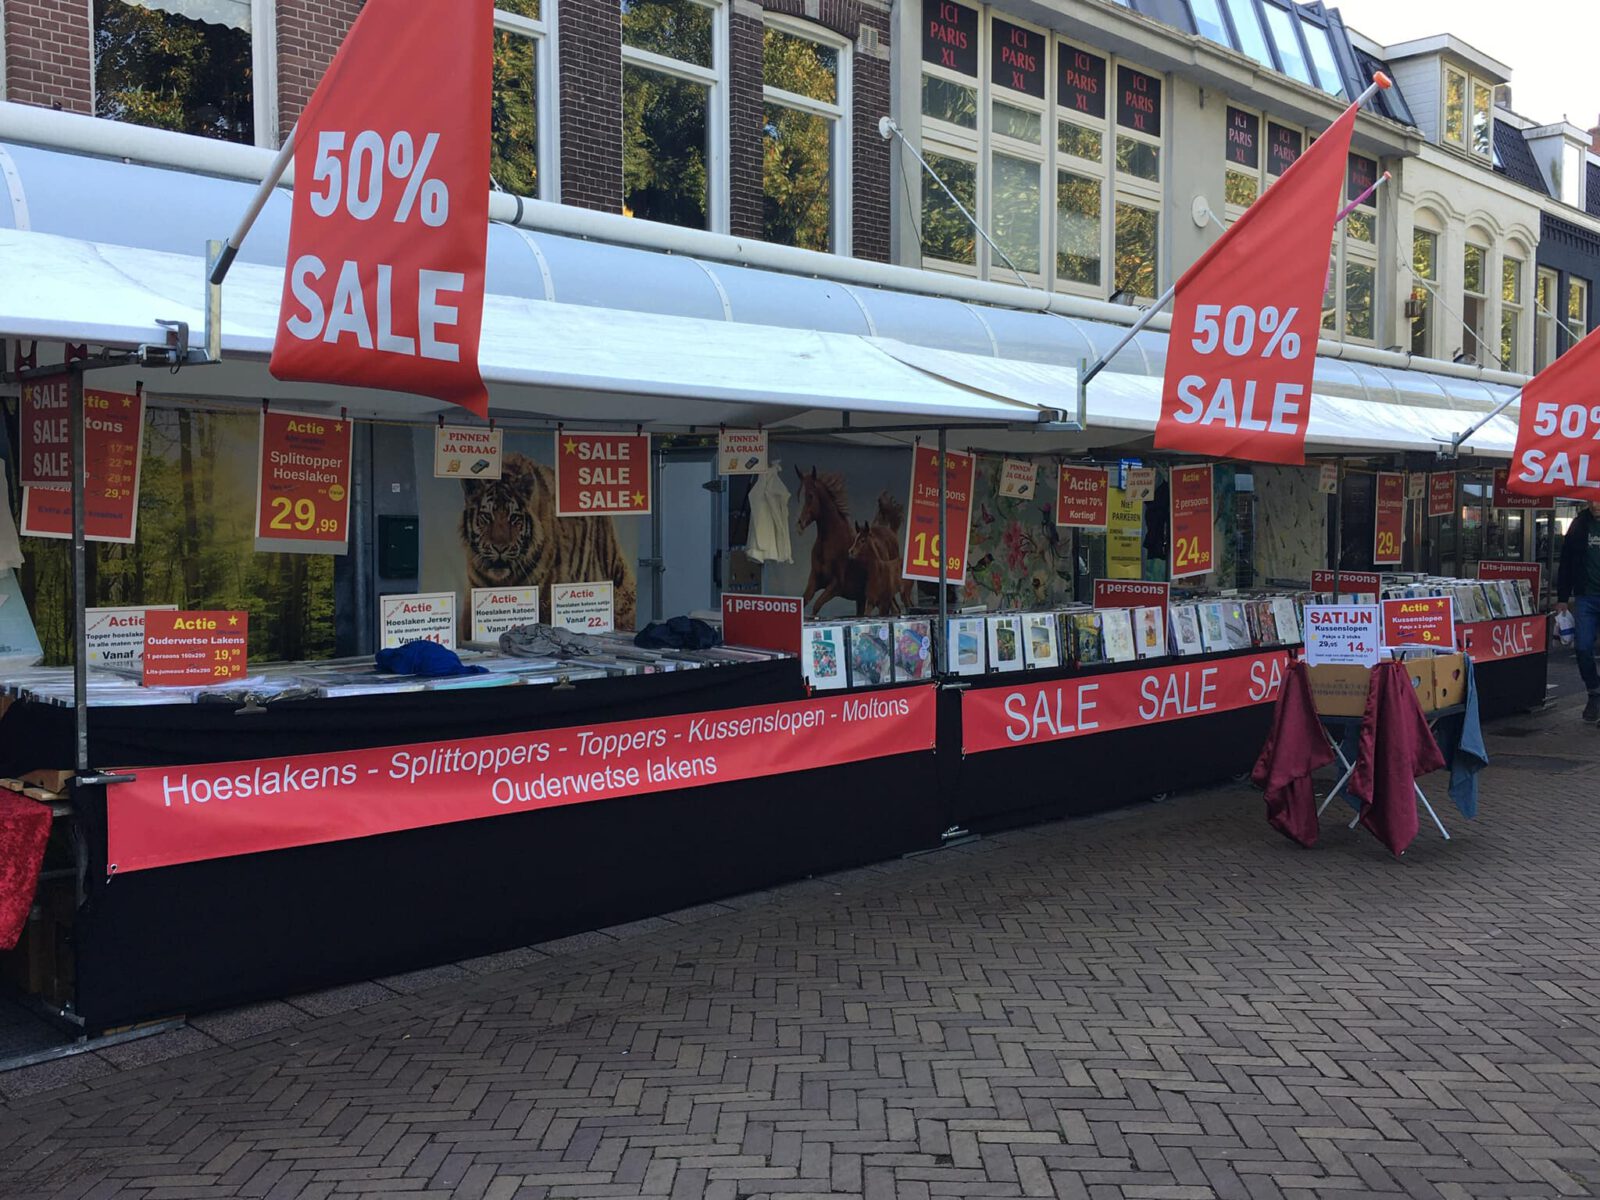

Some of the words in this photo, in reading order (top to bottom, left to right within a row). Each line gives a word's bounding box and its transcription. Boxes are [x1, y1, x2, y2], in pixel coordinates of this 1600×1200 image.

[940, 2, 958, 24] ICI
[930, 21, 967, 49] PARIS
[1011, 29, 1027, 49] ICI
[940, 49, 957, 68] XL
[1002, 47, 1036, 73] PARIS
[1075, 53, 1090, 72] ICI
[1012, 72, 1026, 90] XL
[1066, 70, 1097, 93] PARIS
[1133, 75, 1147, 92] ICI
[1076, 93, 1088, 111] XL
[1125, 91, 1154, 113] PARIS
[1134, 113, 1145, 129] XL
[1235, 114, 1247, 129] ICI
[1228, 127, 1252, 148] PARIS
[1235, 148, 1246, 163] XL
[309, 129, 449, 228] 50%
[286, 254, 465, 363] SALE
[1191, 304, 1301, 360] 50%
[33, 383, 68, 410] SALE
[84, 397, 109, 409] tie
[1173, 374, 1304, 435] SALE
[33, 418, 68, 444] SALE
[287, 420, 325, 435] Actie
[449, 432, 490, 442] PINNEN
[729, 434, 759, 442] PINNEN
[442, 444, 457, 453] JA
[459, 444, 497, 455] GRAAG
[578, 441, 630, 461] SALE
[736, 445, 764, 453] GRAAG
[33, 452, 69, 477] SALE
[270, 450, 343, 469] Splittopper
[273, 467, 338, 484] Hoeslaken
[578, 467, 630, 485] SALE
[1182, 472, 1200, 482] Actie
[1069, 477, 1098, 492] Actie
[578, 490, 630, 509] SALE
[917, 483, 923, 495] 1
[925, 486, 966, 502] peroons
[1063, 496, 1075, 505] Tot
[1075, 497, 1088, 505] wel
[1089, 498, 1103, 507] 70%
[1175, 499, 1180, 509] 2
[1180, 497, 1209, 510] persoons
[1507, 496, 1540, 505] Korting!
[1069, 510, 1096, 522] Korting!
[1111, 512, 1141, 522] PARKEREN
[1176, 536, 1210, 567] 24,99
[1481, 563, 1538, 572] Lits-jumeaux
[1314, 573, 1322, 582] 2
[570, 589, 594, 598] Actie
[1098, 584, 1104, 594] 1
[1107, 584, 1164, 595] persoons
[491, 594, 518, 604] Actie
[726, 600, 733, 613] 1
[735, 599, 798, 613] persoons
[403, 602, 432, 614] Actie
[1400, 603, 1429, 613] Actie
[108, 616, 145, 627] Actie
[173, 617, 217, 630] Actie
[386, 618, 426, 627] Hoeslaken
[427, 616, 452, 624] Jersey
[566, 616, 586, 624] Vanaf
[1310, 611, 1373, 624] SATIJN
[1392, 615, 1443, 623] Kussenslopen
[487, 625, 509, 633] Vanaf
[1314, 625, 1368, 633] Kussenslopen
[147, 636, 208, 645] Ouderwetse
[210, 636, 245, 645] Lakens
[1492, 621, 1533, 657] SALE
[102, 650, 134, 660] Vanaf
[1003, 683, 1099, 742] SALE
[1138, 667, 1218, 720] SALE
[161, 762, 357, 807] Hoeslakens
[389, 742, 550, 784] Splittoppers
[576, 726, 667, 759] Toppers
[688, 706, 825, 744] Kussenslopen
[842, 697, 910, 722] Moltons
[492, 767, 640, 805] Ouderwetse
[646, 753, 718, 783] lakens
